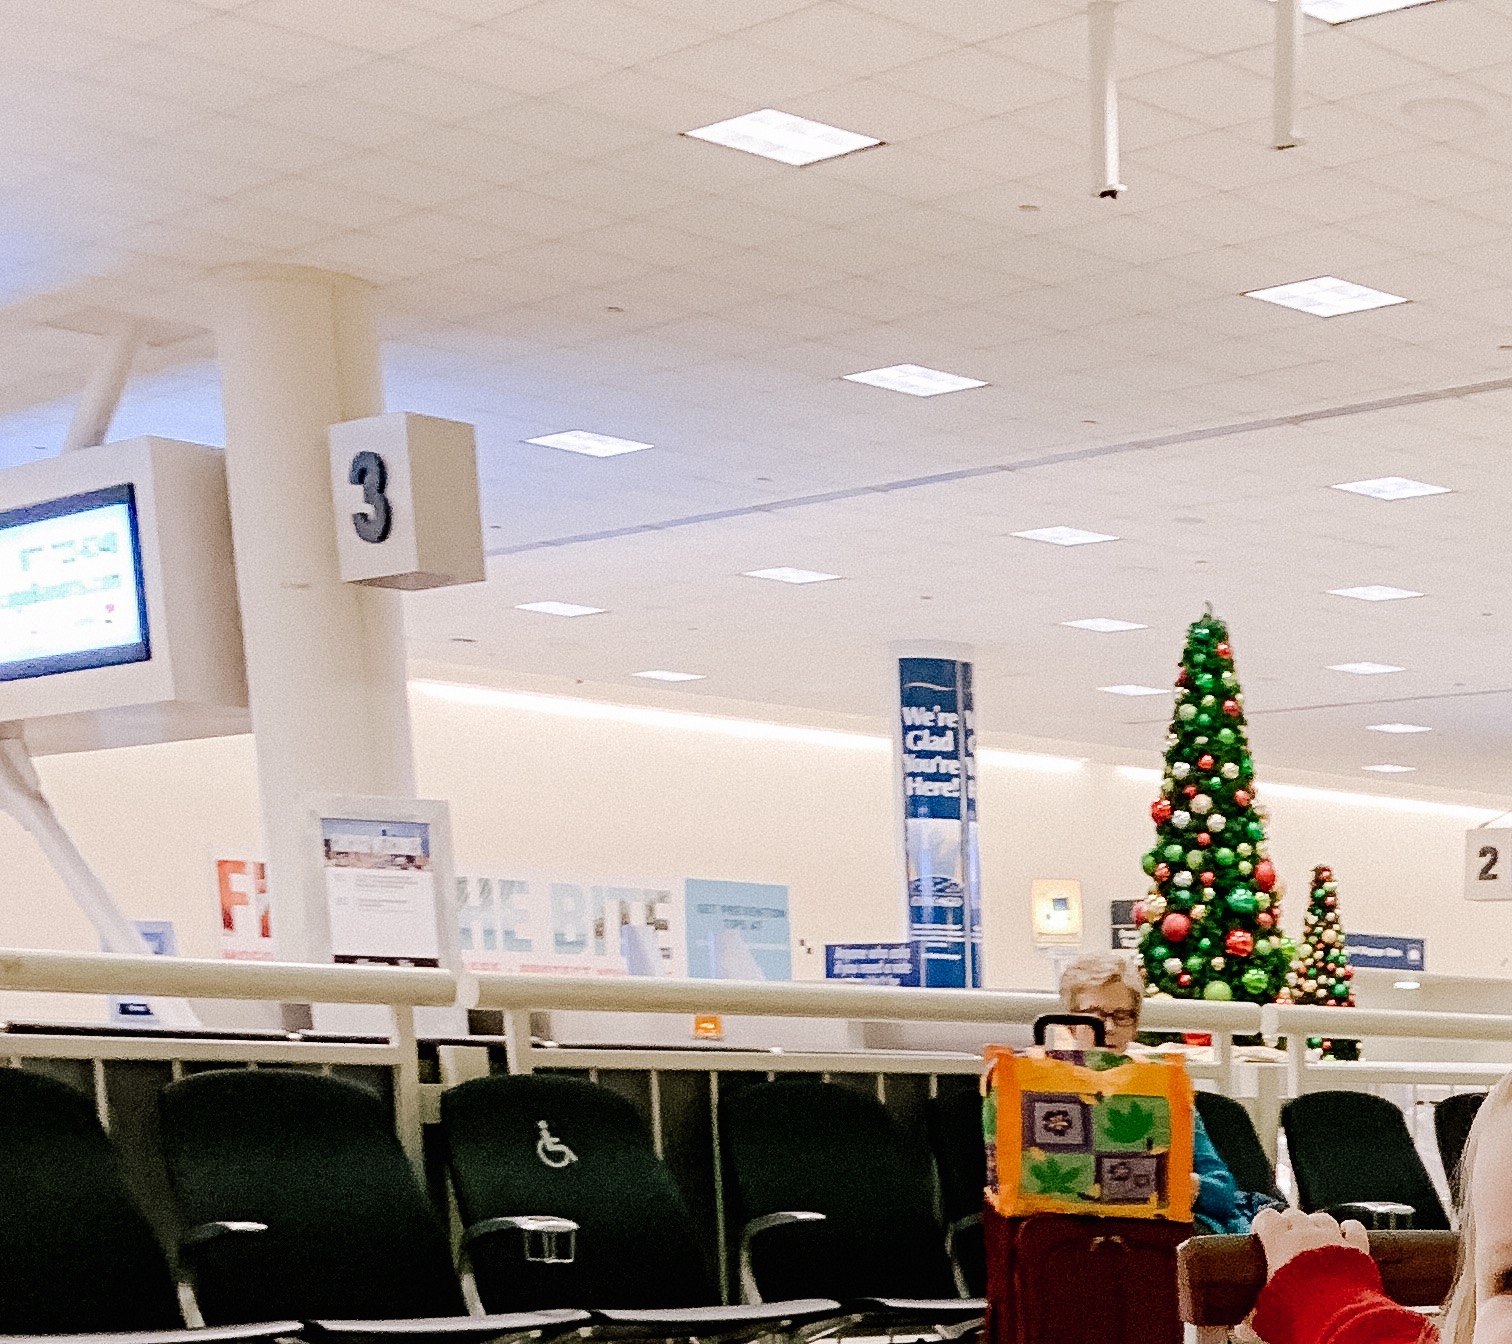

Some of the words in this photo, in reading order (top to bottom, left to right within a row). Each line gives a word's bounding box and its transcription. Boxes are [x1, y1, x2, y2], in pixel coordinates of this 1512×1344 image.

[350, 451, 392, 543] 3
[902, 706, 959, 727] We're
[905, 729, 954, 751] Glad
[1478, 846, 1498, 880] 2
[455, 876, 532, 952] HE
[550, 882, 672, 958] BITE
